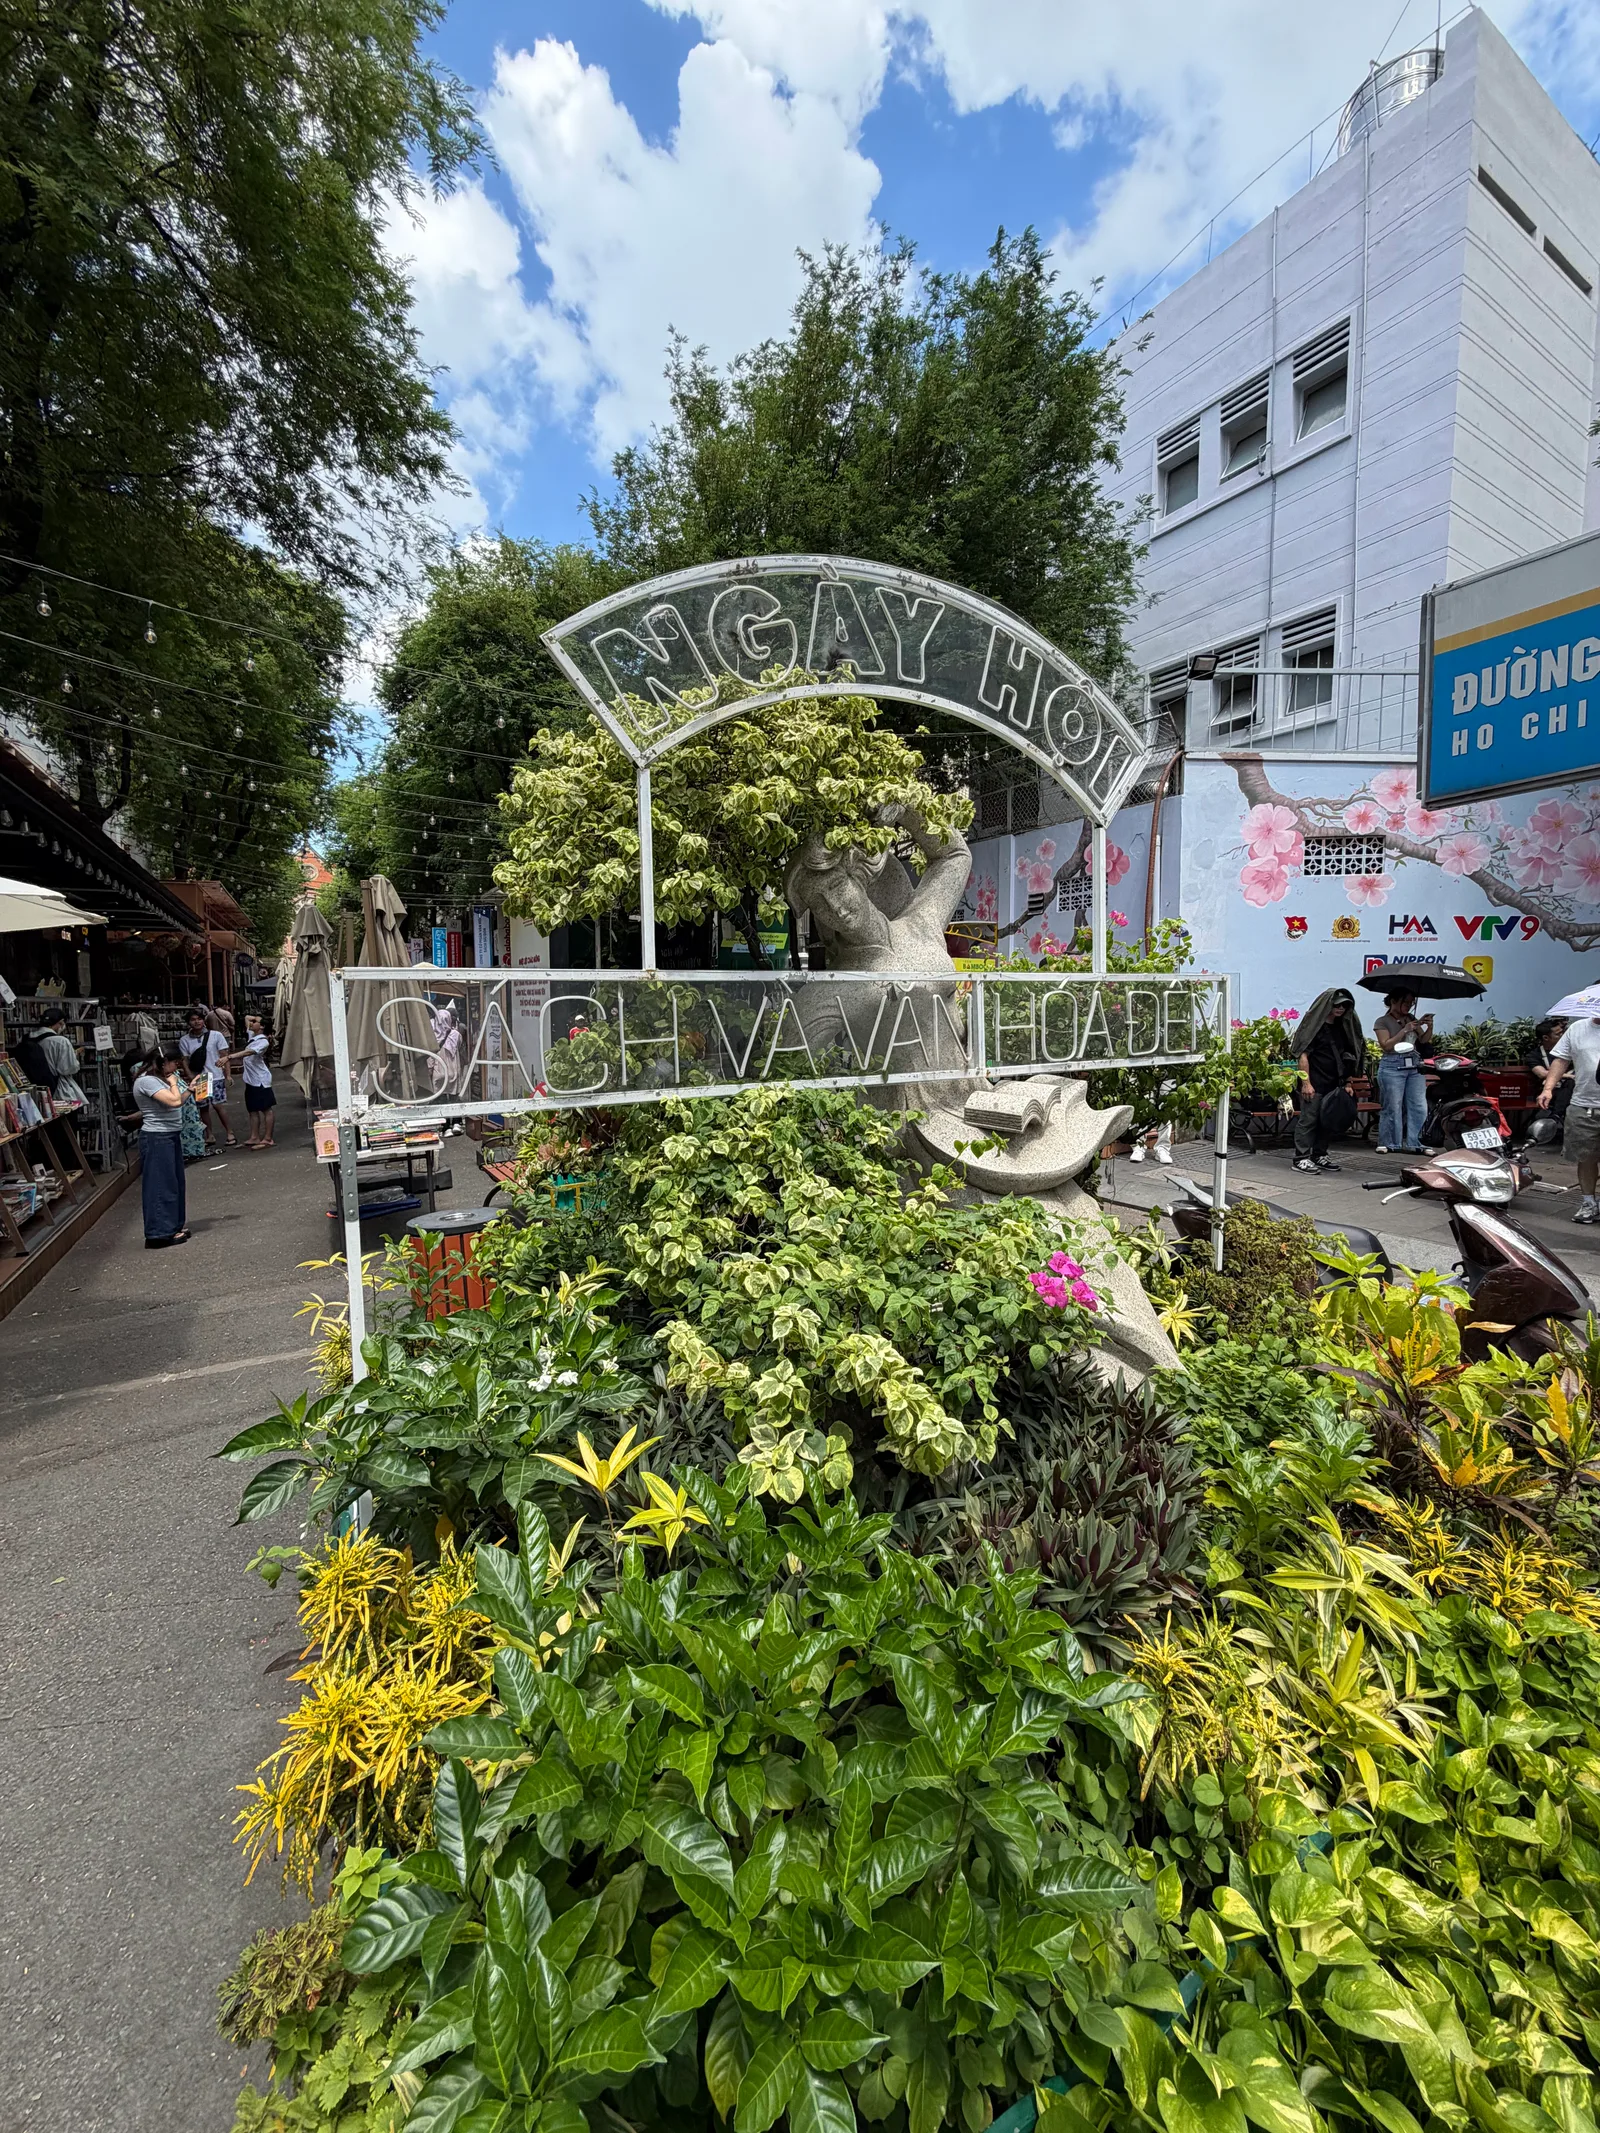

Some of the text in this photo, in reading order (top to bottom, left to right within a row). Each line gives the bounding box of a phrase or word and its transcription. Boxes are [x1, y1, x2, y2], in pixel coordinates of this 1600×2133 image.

[590, 561, 1133, 804] NGÀY HỘI
[1452, 637, 1600, 716] ĐƯỜNG
[1452, 699, 1588, 757] HO CHI
[1388, 914, 1438, 935] HAA
[1453, 915, 1541, 941] VTV9
[1392, 955, 1448, 965] NIPPON
[371, 975, 1224, 1104] SÁCH VÀ VĂN HÓA ĐÊM
[1467, 1130, 1492, 1142] 59-T1
